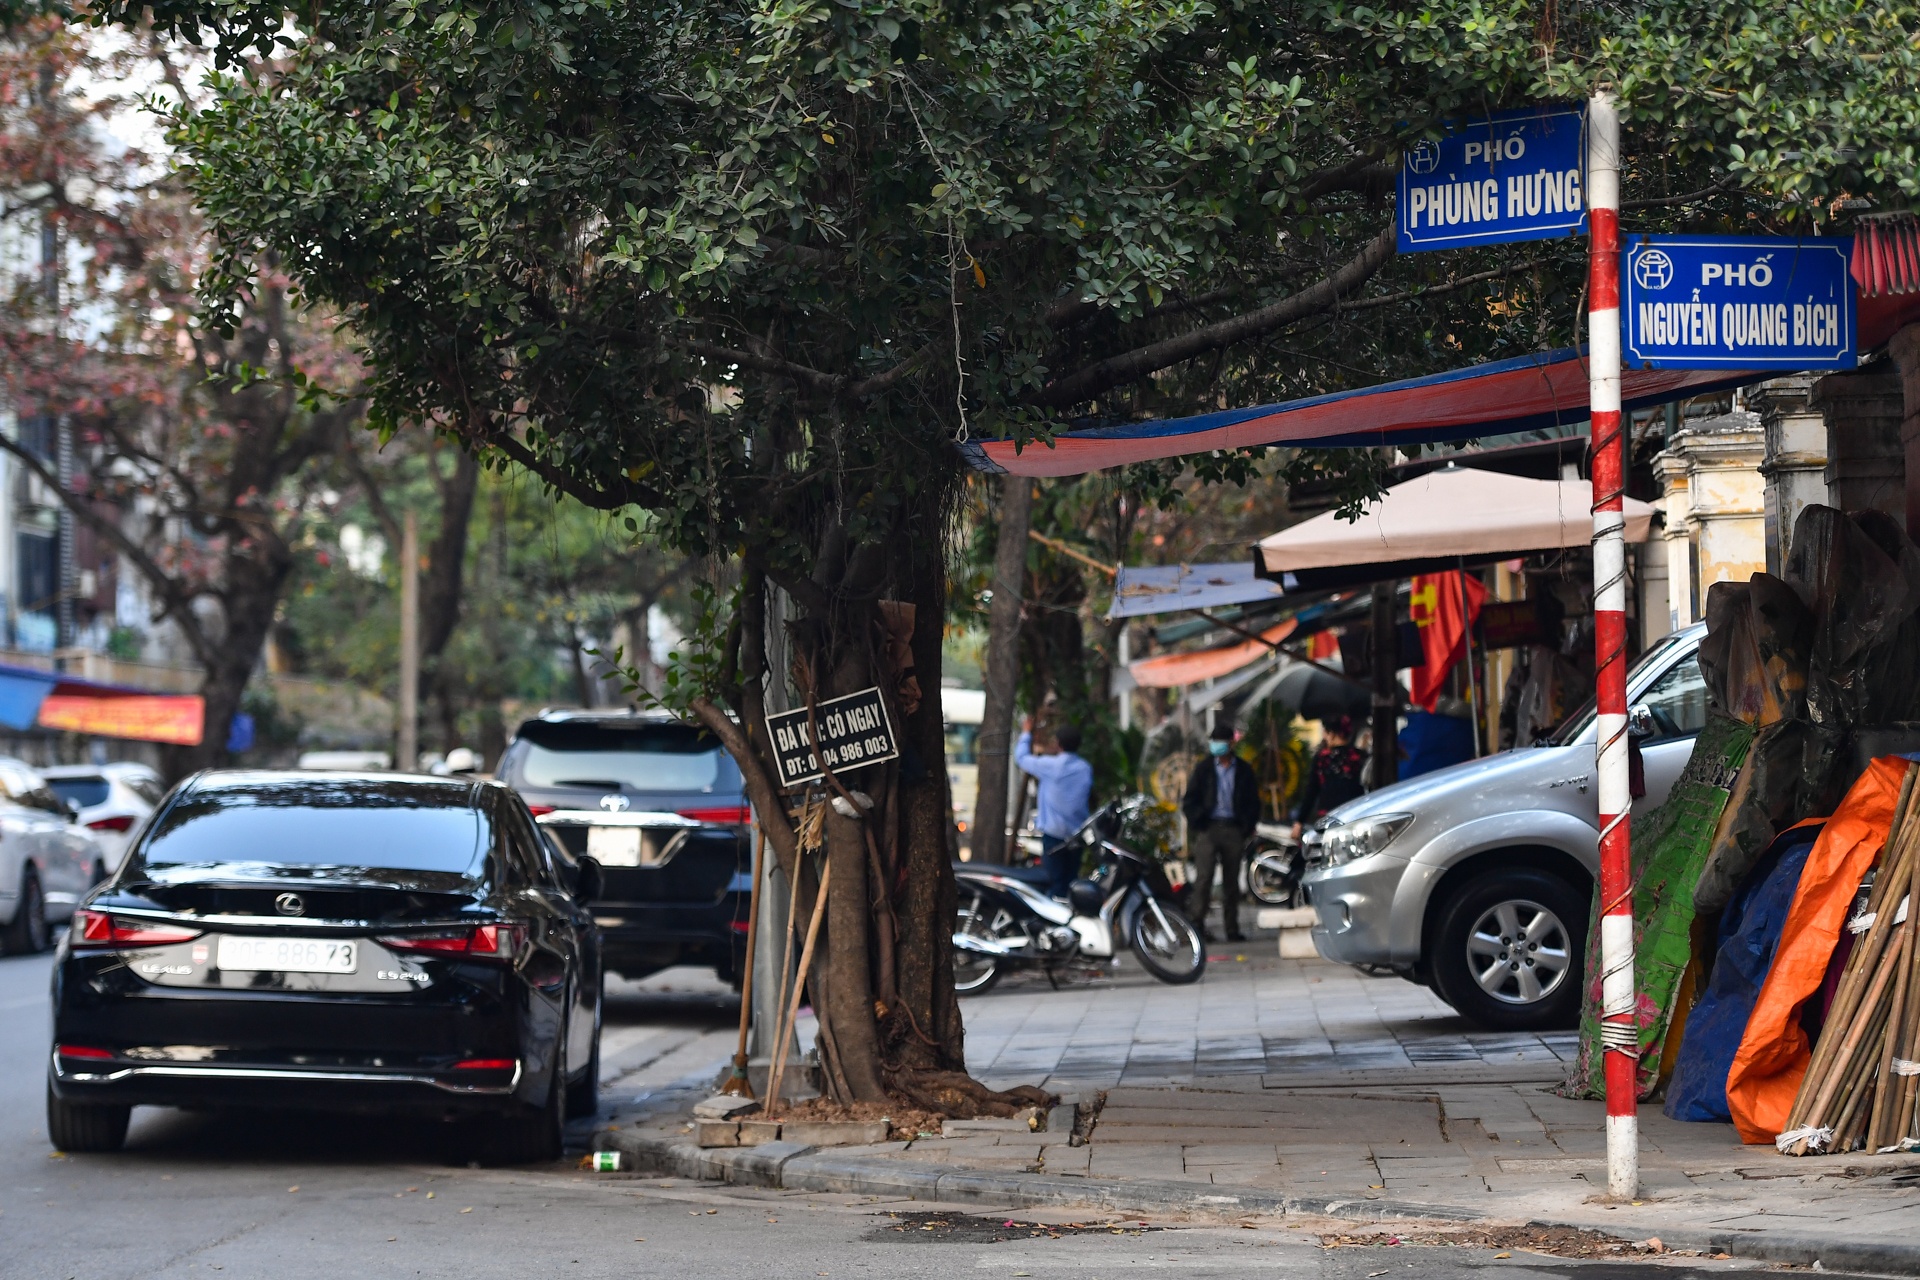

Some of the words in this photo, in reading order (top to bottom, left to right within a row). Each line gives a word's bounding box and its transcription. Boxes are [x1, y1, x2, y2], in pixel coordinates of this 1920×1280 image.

[1465, 126, 1525, 164] PHỐ
[1410, 173, 1498, 228] PHÙNG
[1507, 168, 1581, 218] HƯNG
[1702, 254, 1774, 287] PHỐ
[1639, 288, 1717, 346] NGUYỄN
[1722, 303, 1788, 351] QUANG
[1793, 296, 1838, 347] BÍCH
[776, 720, 799, 752] ĐÁ
[825, 707, 846, 739] CÓ
[845, 702, 881, 734] NGAY
[785, 756, 807, 776] ĐT:
[807, 748, 839, 770] 004
[839, 741, 864, 762] 986
[864, 735, 889, 756] 003
